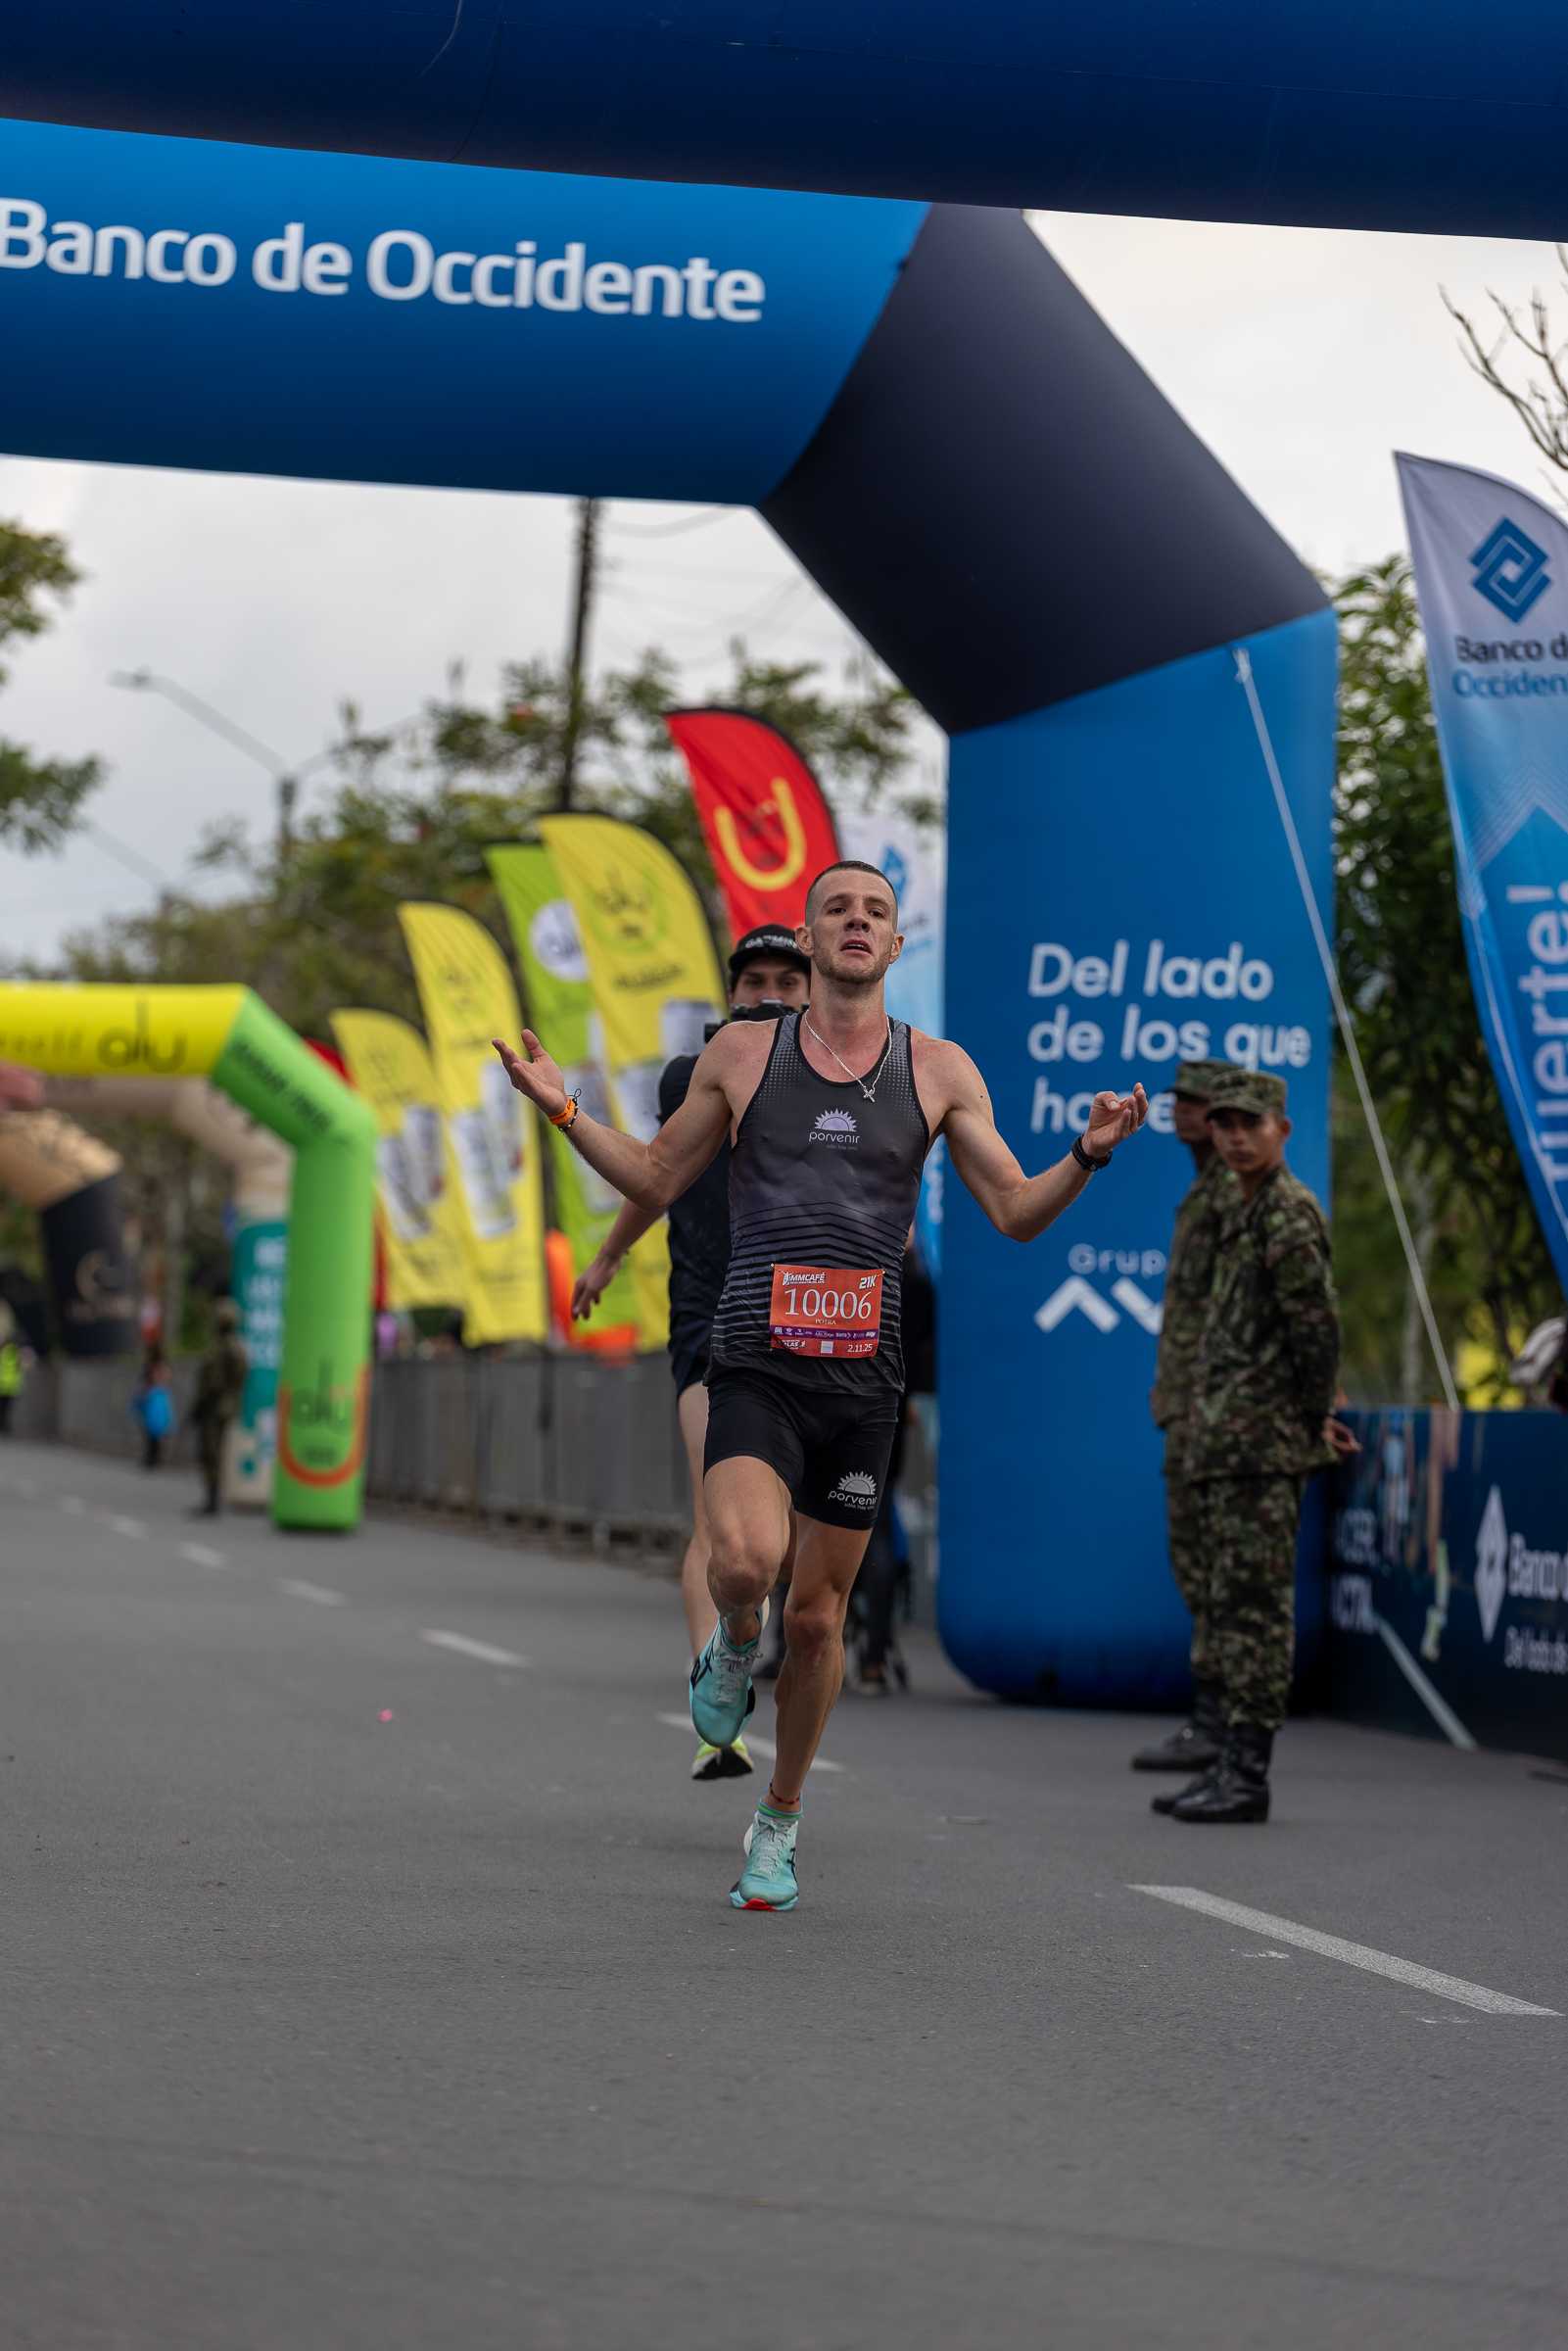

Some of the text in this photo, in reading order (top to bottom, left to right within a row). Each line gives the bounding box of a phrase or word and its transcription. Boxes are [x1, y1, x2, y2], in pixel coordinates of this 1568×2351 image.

[0, 198, 767, 323] Banco de Occidente
[1455, 636, 1544, 663] Banco
[1027, 938, 1275, 1001] Del lado
[1026, 1003, 1312, 1072] de los que
[808, 1131, 861, 1144] porvenir
[1068, 1242, 1168, 1279] Grup
[859, 1274, 877, 1290] 21K
[784, 1288, 873, 1319] 10006
[846, 1343, 874, 1353] 2.11.25
